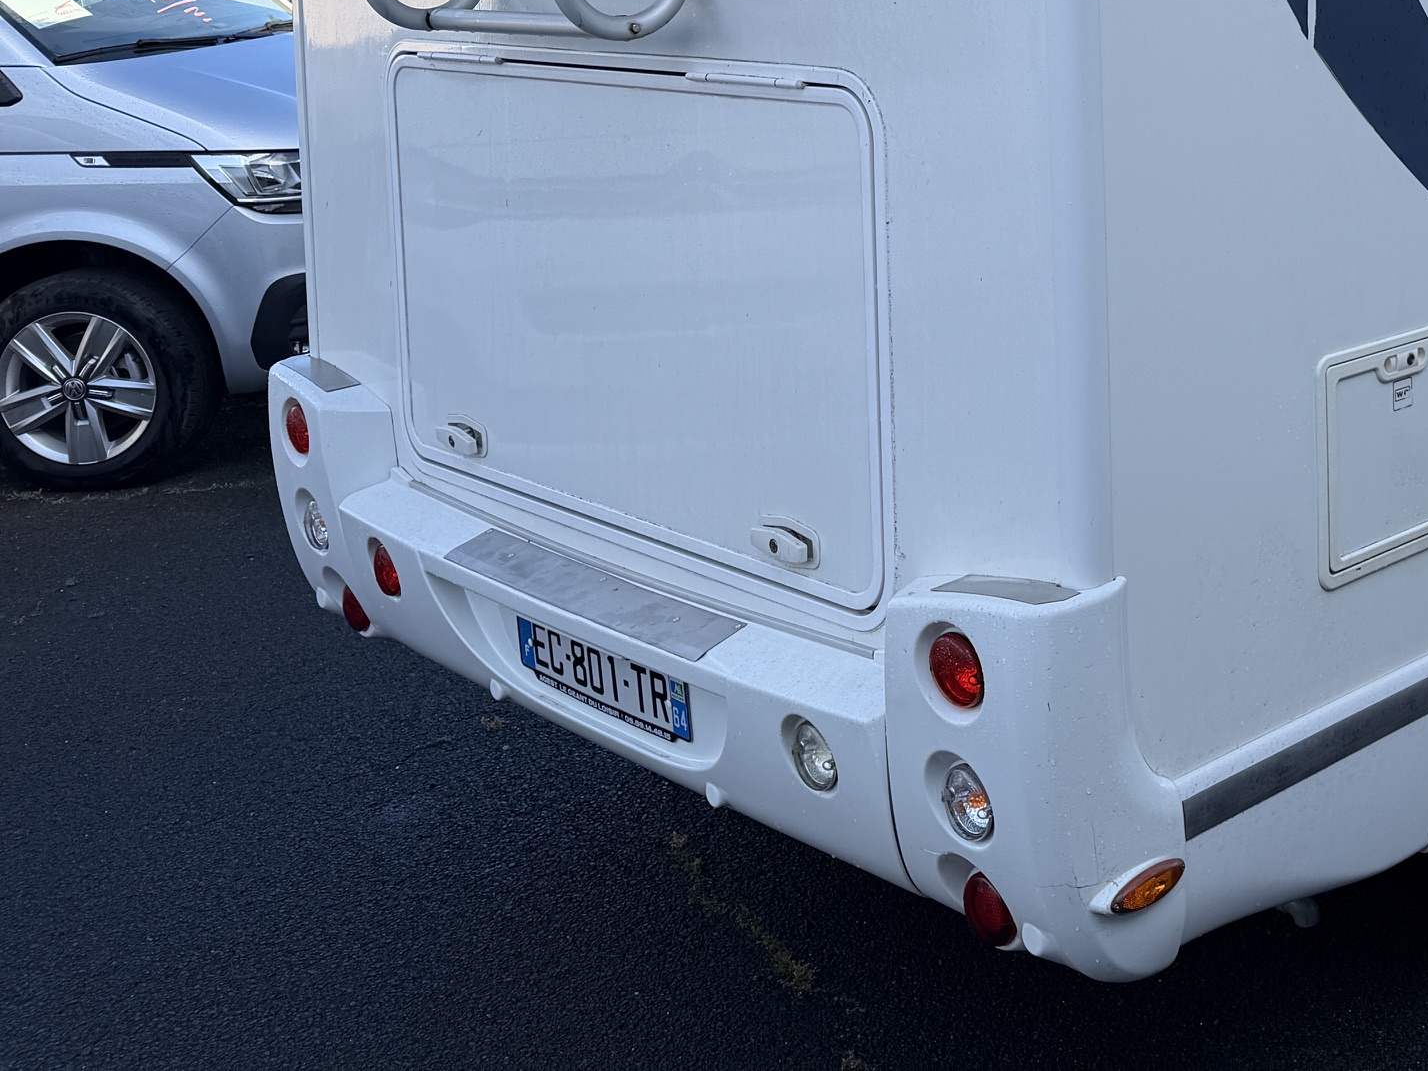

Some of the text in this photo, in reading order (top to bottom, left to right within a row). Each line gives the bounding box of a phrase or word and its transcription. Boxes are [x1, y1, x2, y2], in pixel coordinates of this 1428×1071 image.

[532, 622, 670, 724] EC-801-TR
[588, 698, 598, 709] DU
[672, 706, 688, 731] 64
